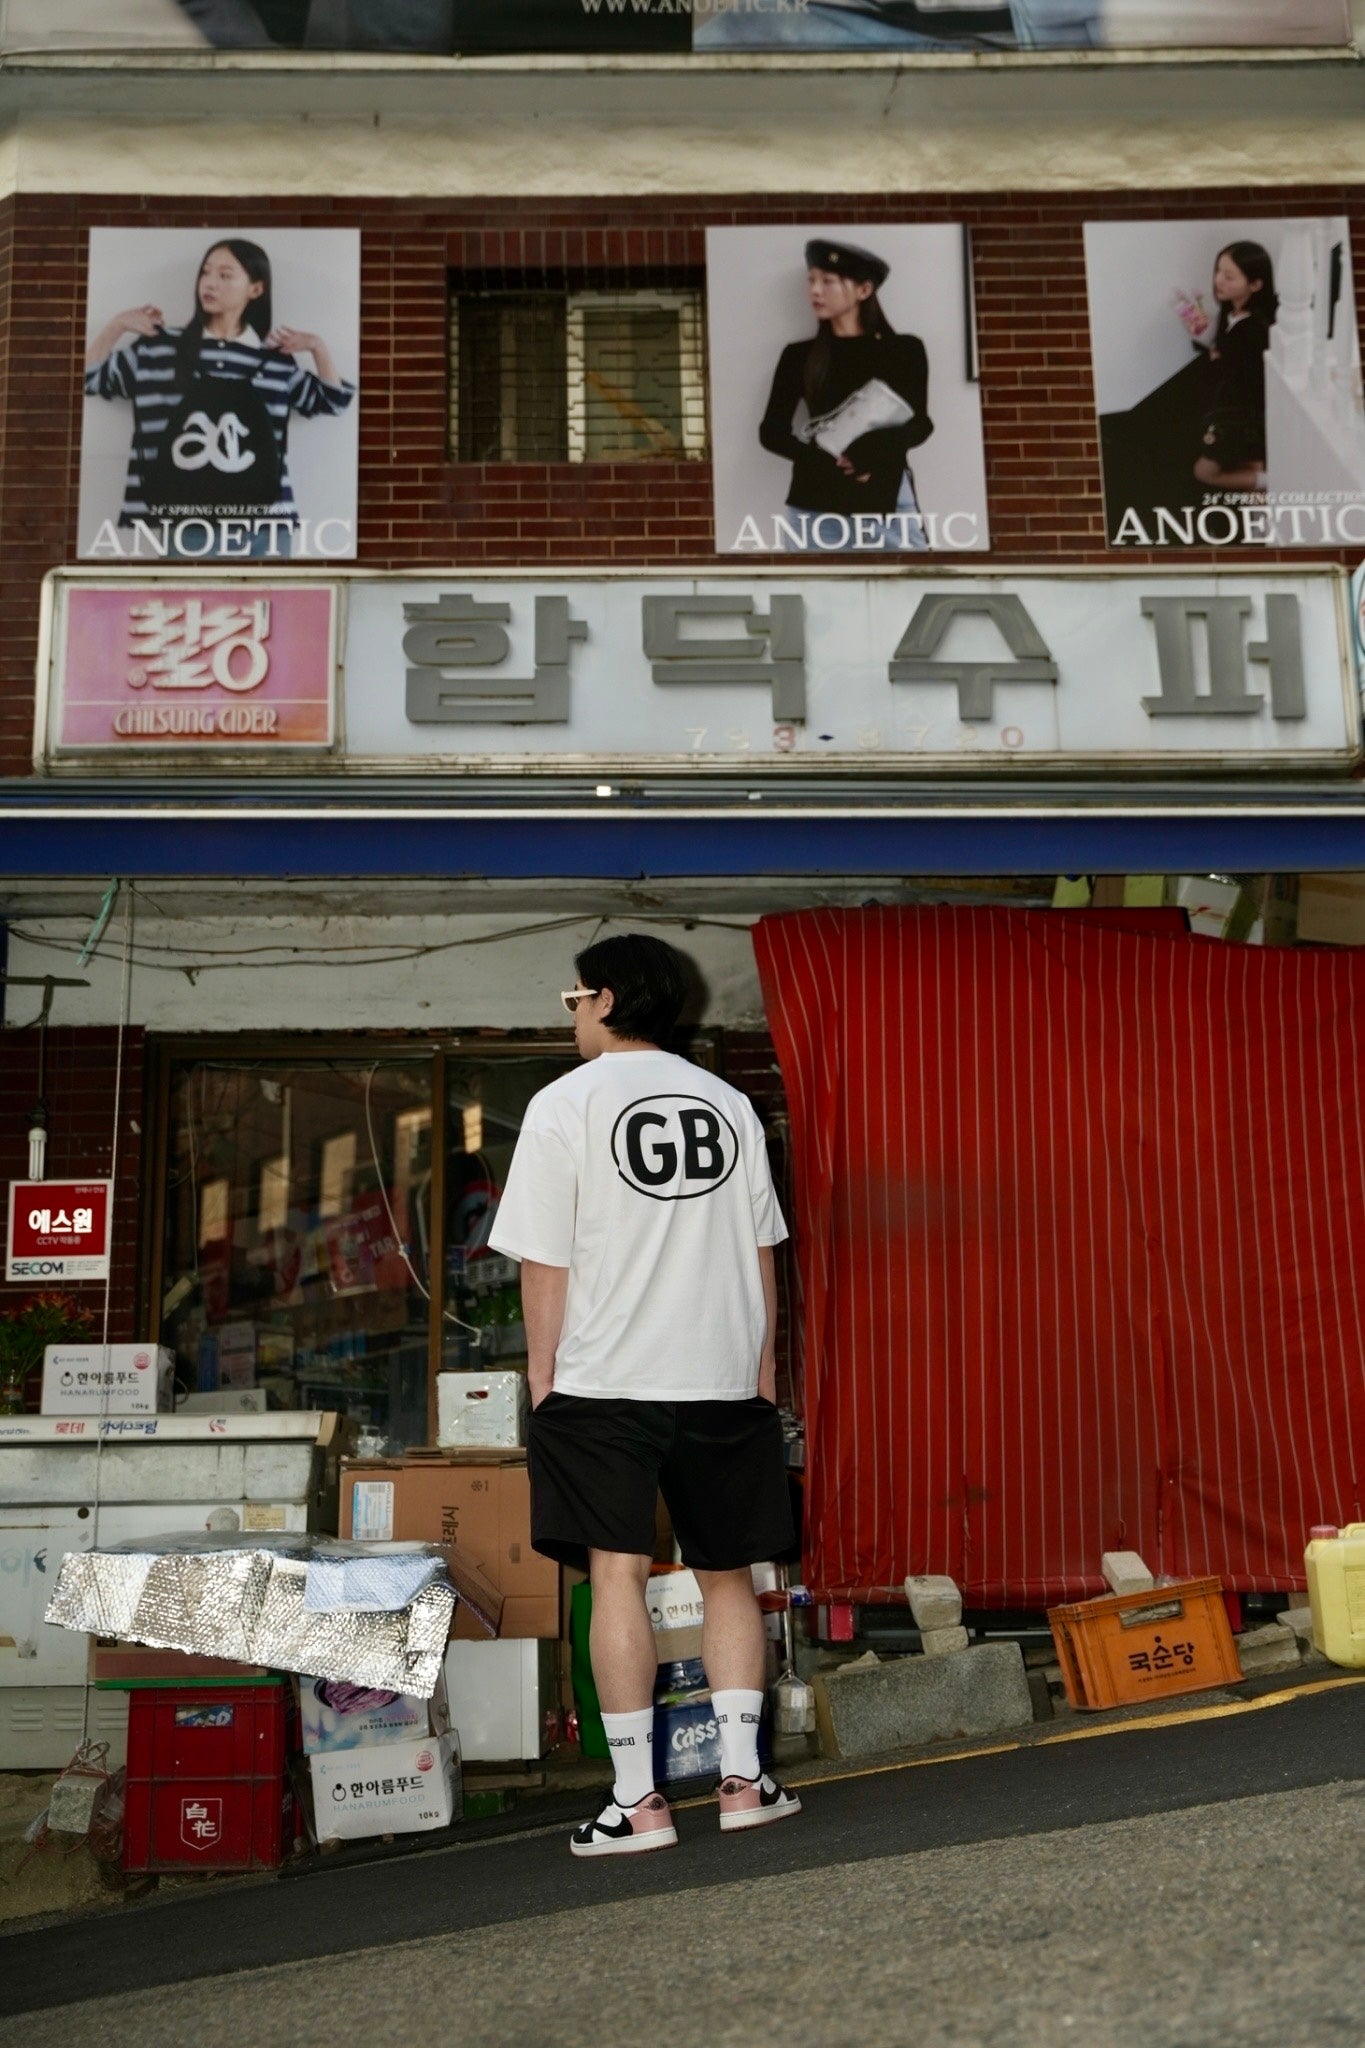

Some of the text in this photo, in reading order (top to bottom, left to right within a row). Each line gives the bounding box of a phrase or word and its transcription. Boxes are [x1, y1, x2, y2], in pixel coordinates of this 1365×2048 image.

[168, 504, 213, 516] SPRING
[1223, 490, 1276, 506] SPRING
[87, 518, 351, 557] ANOETIC
[730, 512, 979, 550] ANOETIC
[1110, 504, 1365, 546] ANOETIC
[128, 600, 271, 692] 칠성
[114, 704, 279, 735] CHILSUNG CIDER
[626, 1108, 725, 1186] GB
[28, 1207, 93, 1234] 에스원
[37, 1236, 59, 1246] CCTV
[12, 1261, 64, 1276] SECOM
[1128, 1636, 1195, 1671] 국순당
[350, 1775, 425, 1799] 한아름푸드
[331, 1794, 426, 1813] HANARUMFOOD
[418, 1810, 440, 1821] 10kg
